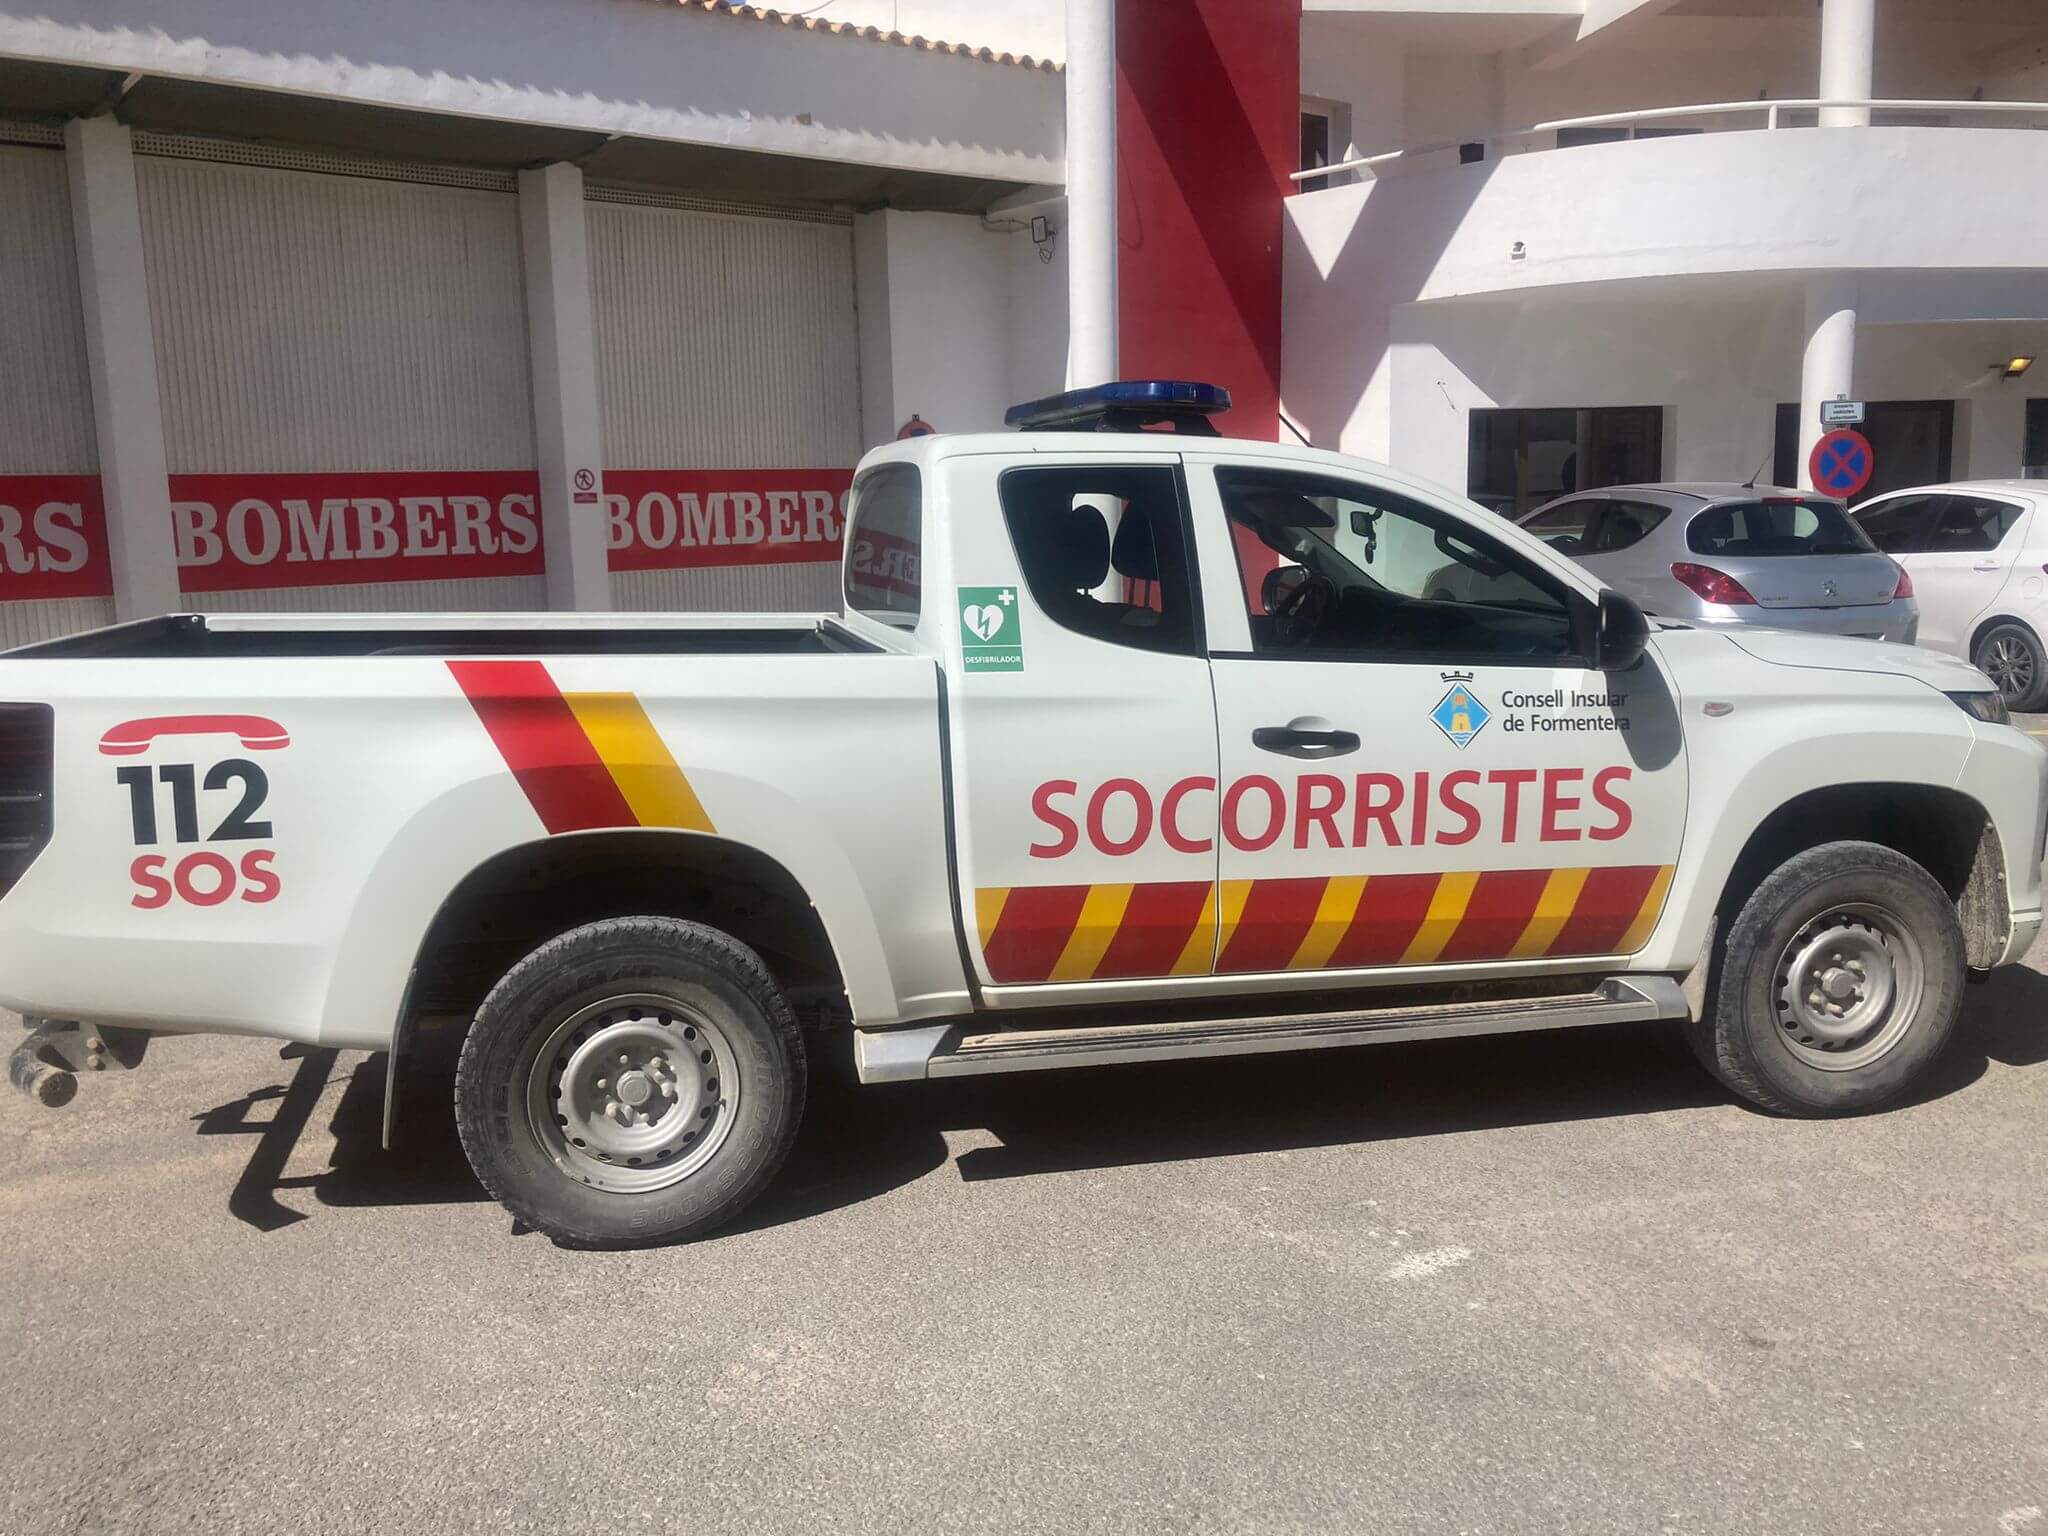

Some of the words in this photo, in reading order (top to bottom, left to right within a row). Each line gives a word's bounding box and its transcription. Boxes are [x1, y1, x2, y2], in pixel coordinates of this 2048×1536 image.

[172, 493, 538, 568] BOMBERS
[964, 655, 1021, 664] DESFIBRILADOR
[1501, 689, 1564, 708] Consell
[1571, 689, 1629, 708] Insular
[1502, 714, 1526, 732] de
[1531, 714, 1630, 732] Formentera
[116, 758, 273, 846] 112
[1028, 765, 1633, 860] SOCORRISTES
[129, 849, 281, 910] SOS
